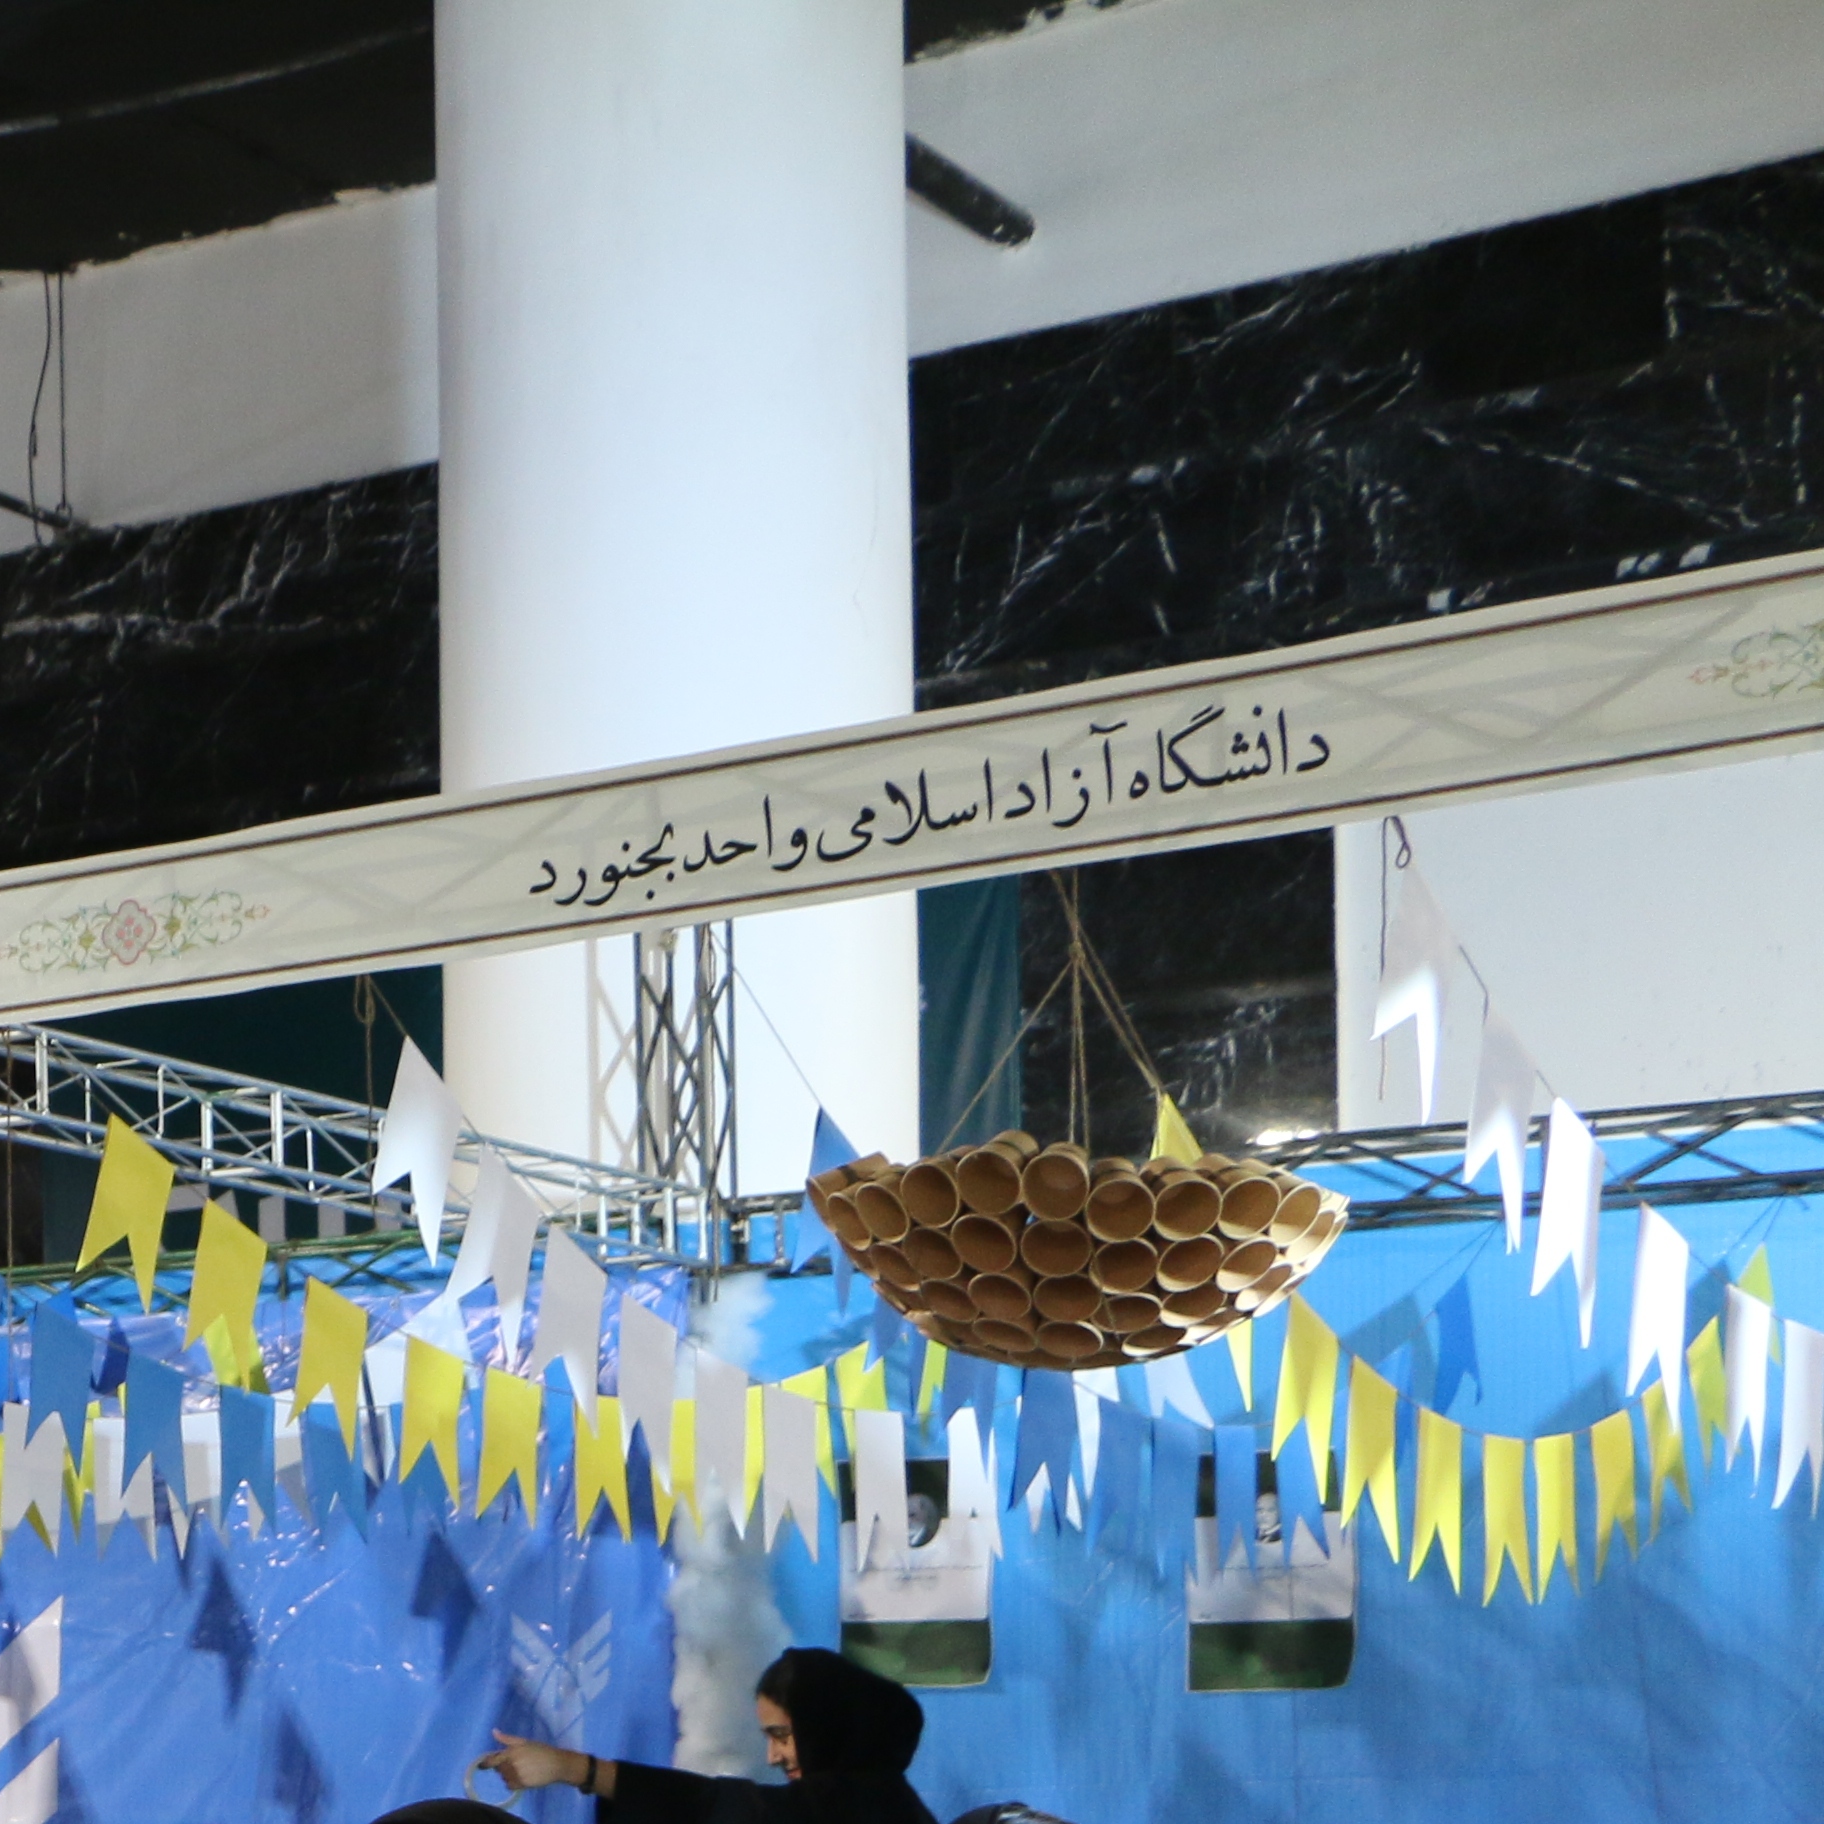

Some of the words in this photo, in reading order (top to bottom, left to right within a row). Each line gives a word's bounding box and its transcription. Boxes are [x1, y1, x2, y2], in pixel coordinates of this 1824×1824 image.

[1005, 720, 1127, 829] آزاد
[1127, 704, 1332, 800] دانشگاه
[696, 797, 808, 873] واحد
[816, 758, 993, 862] اسلامی
[530, 823, 680, 907] بجنورد
